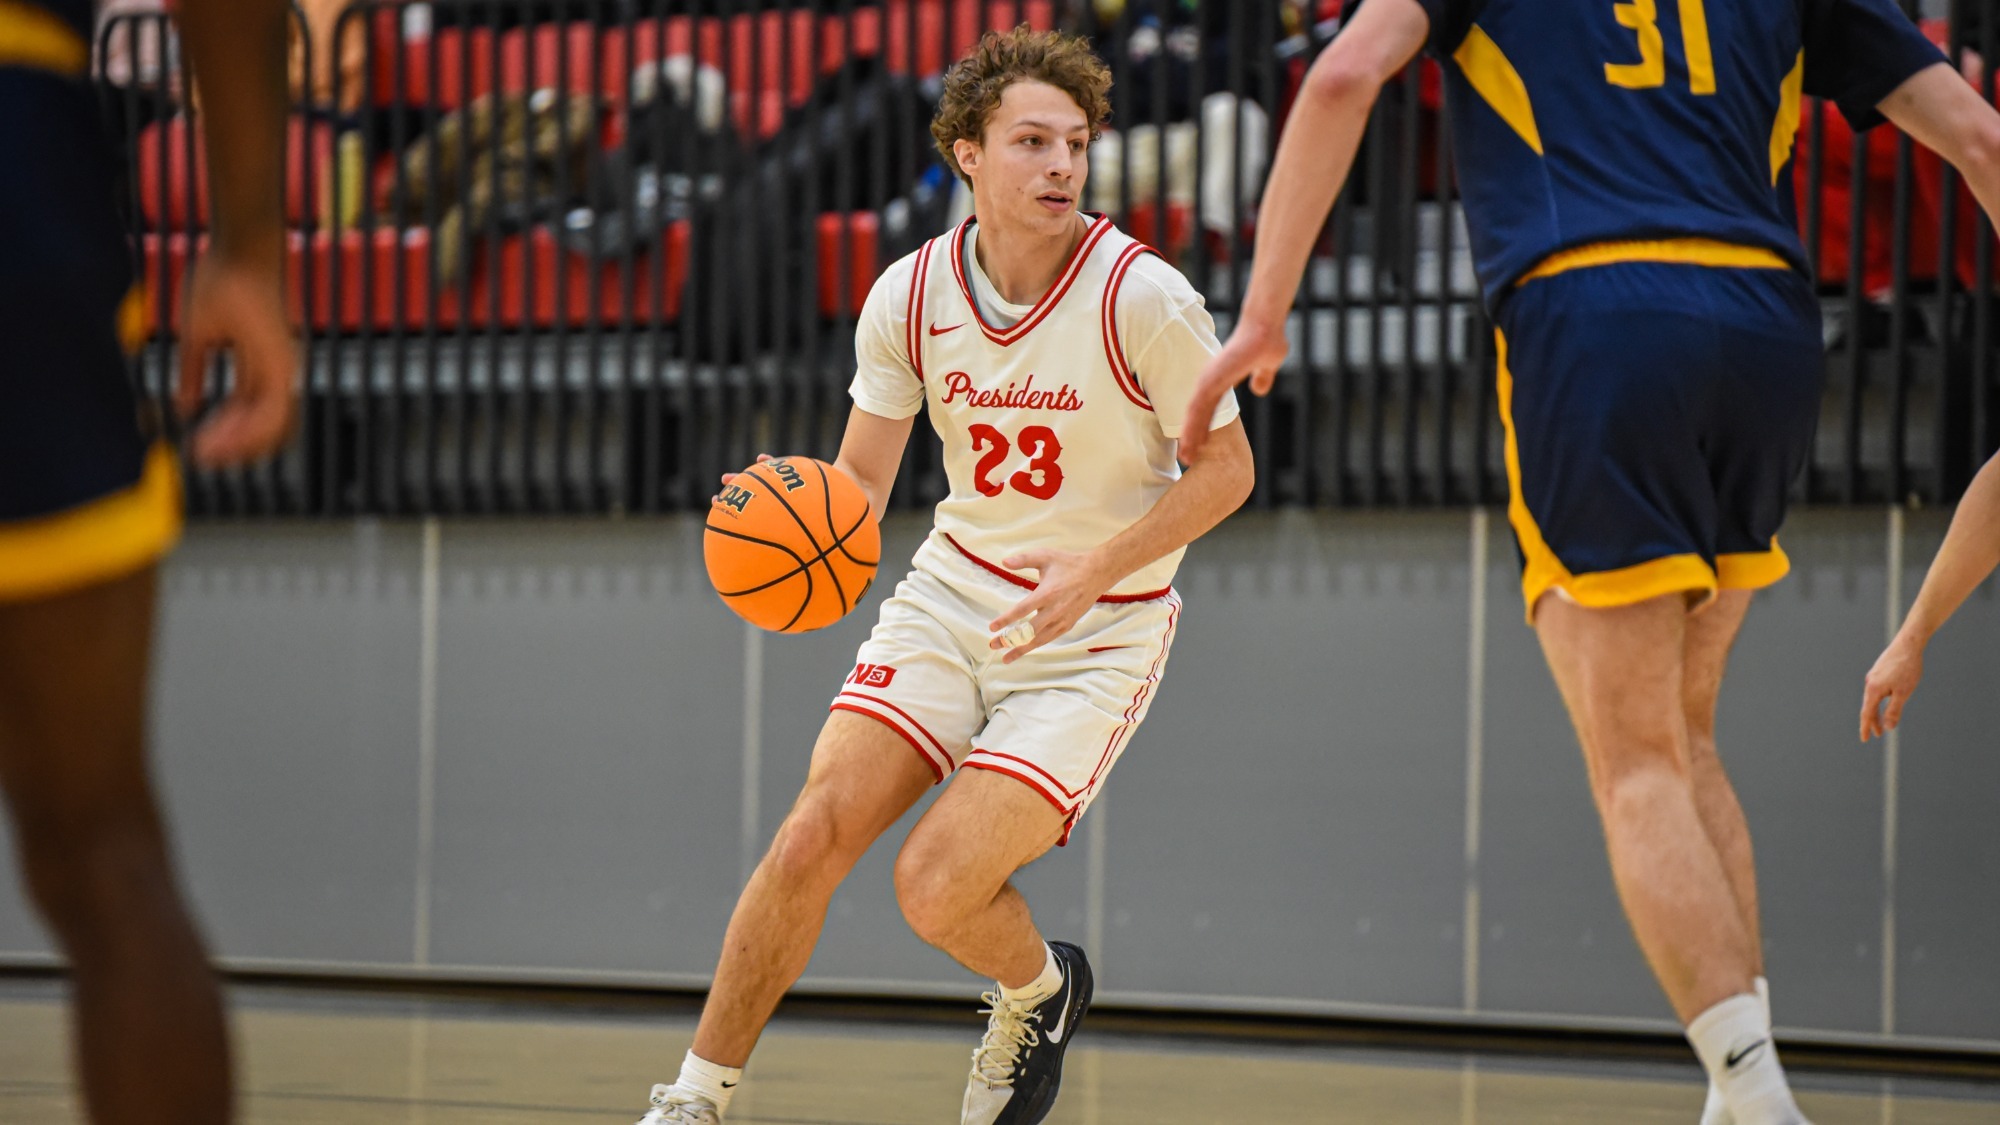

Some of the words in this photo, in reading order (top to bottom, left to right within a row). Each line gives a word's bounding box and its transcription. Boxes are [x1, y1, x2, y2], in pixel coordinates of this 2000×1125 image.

[1604, 0, 1717, 95] 31
[942, 371, 1084, 411] Presidents
[968, 424, 1065, 500] 23
[717, 484, 754, 513] CAA
